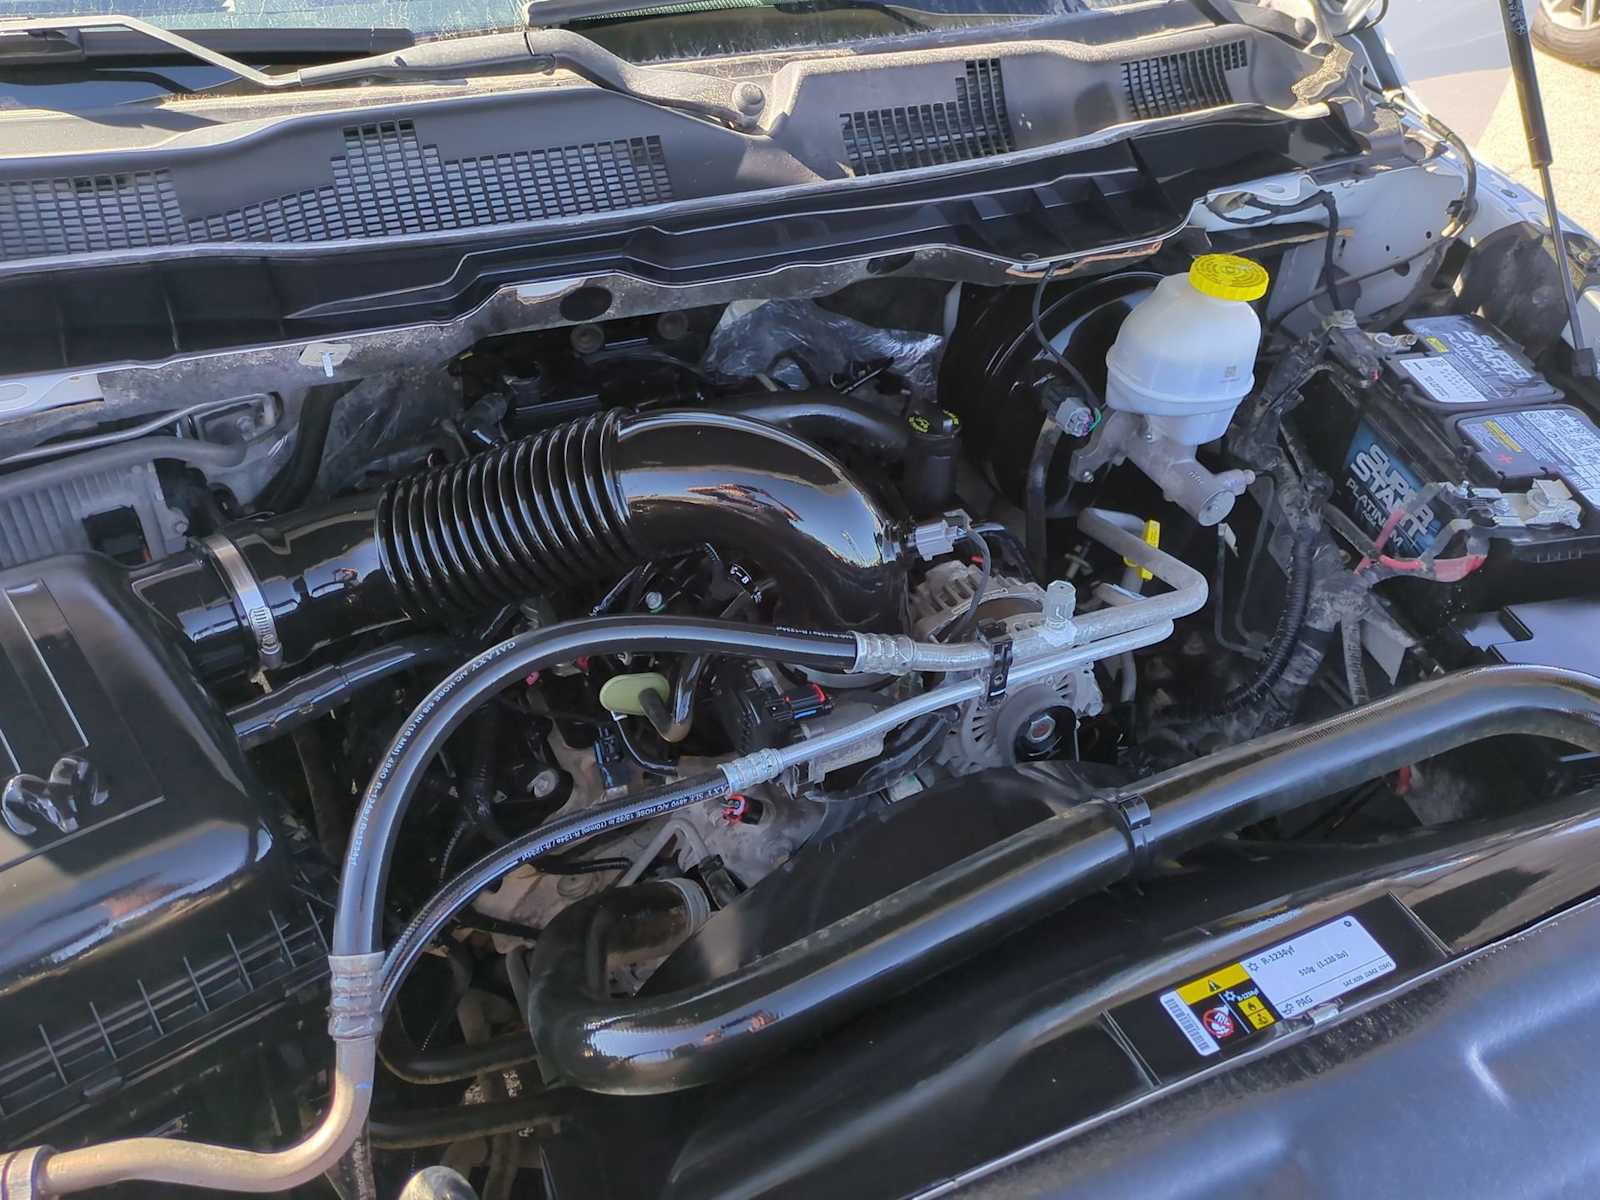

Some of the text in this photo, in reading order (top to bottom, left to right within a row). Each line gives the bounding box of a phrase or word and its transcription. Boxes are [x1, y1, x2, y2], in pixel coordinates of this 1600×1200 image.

[1440, 332, 1491, 374] PLATINUM
[1454, 328, 1522, 381] START
[1479, 334, 1533, 379] SUPER
[1345, 477, 1404, 548] PLATINM
[471, 641, 516, 672] GALAXY
[433, 681, 456, 702] HOSE
[414, 713, 425, 724] IN
[404, 723, 417, 737] (16
[391, 736, 408, 756] MM)
[379, 757, 395, 780] 4860
[363, 781, 384, 818] R-134a
[656, 803, 670, 813] A/C
[635, 807, 657, 818] HOSE
[556, 831, 581, 845] R-134a
[581, 820, 608, 835] (10mm)
[1260, 944, 1297, 966] R-1234yf
[1295, 994, 1314, 1008] PAG
